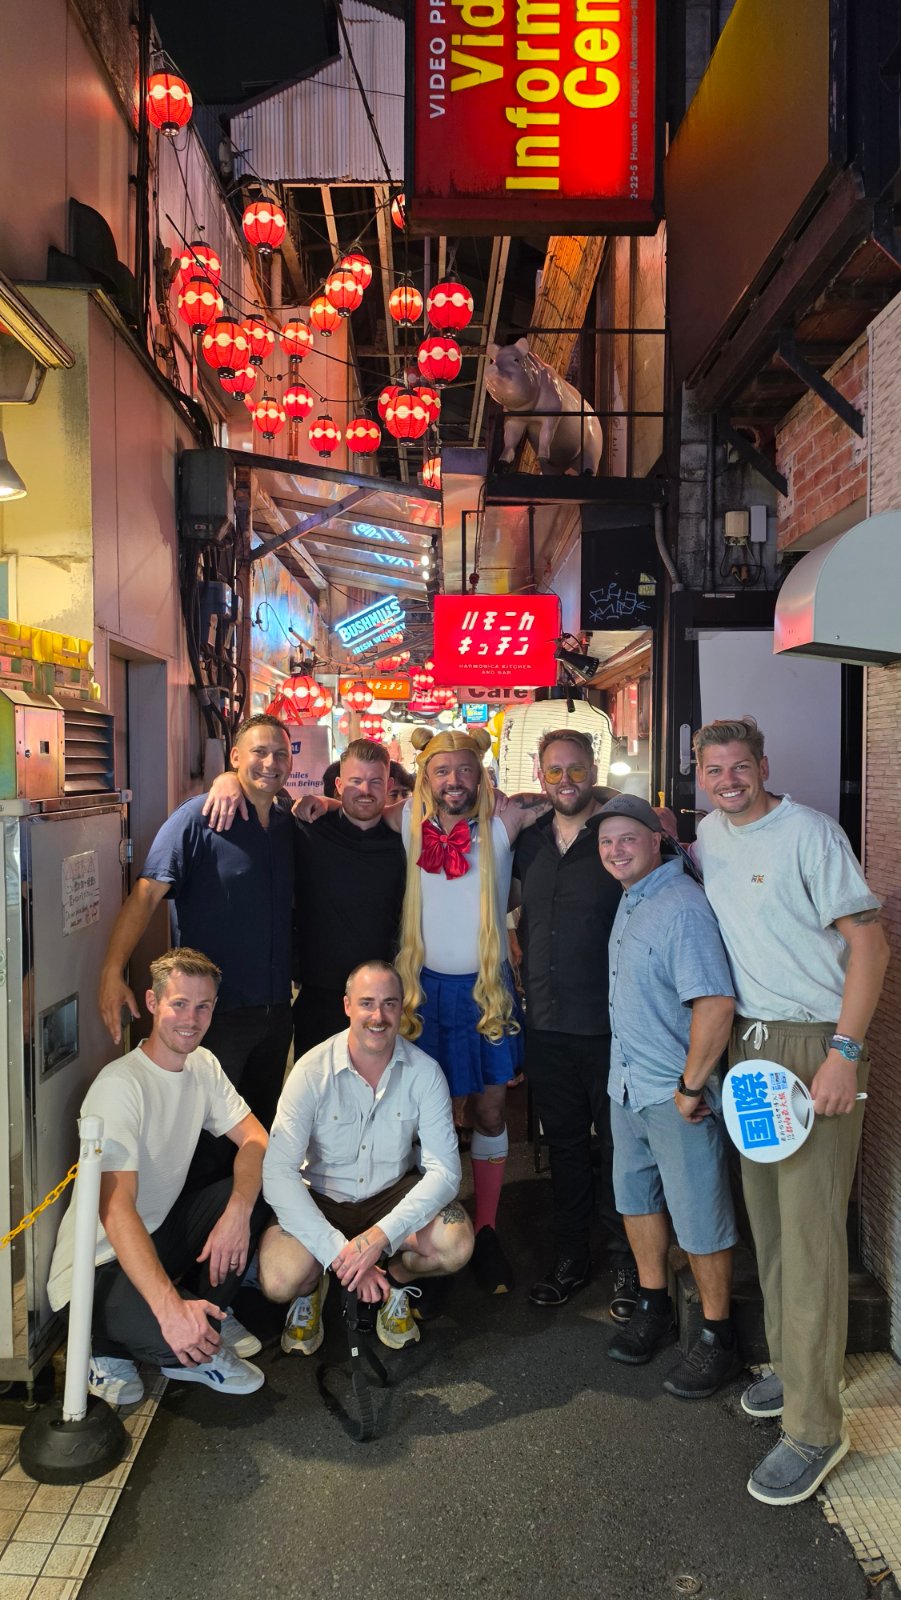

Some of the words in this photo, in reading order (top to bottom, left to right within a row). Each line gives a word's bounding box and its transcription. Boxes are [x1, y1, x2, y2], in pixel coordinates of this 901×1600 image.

[450, 0, 505, 92] Vid
[563, 0, 621, 109] Cen
[429, 37, 446, 119] VIDEO
[505, 0, 561, 190] Inform
[629, 165, 639, 200] 2-22-5
[338, 600, 401, 642] BUSHMILLS
[352, 640, 374, 655] IRISH
[373, 622, 406, 646] WHISKEY
[458, 636, 529, 656] キッチン
[461, 611, 535, 631] ハモニカ
[730, 1071, 780, 1150] 国際
